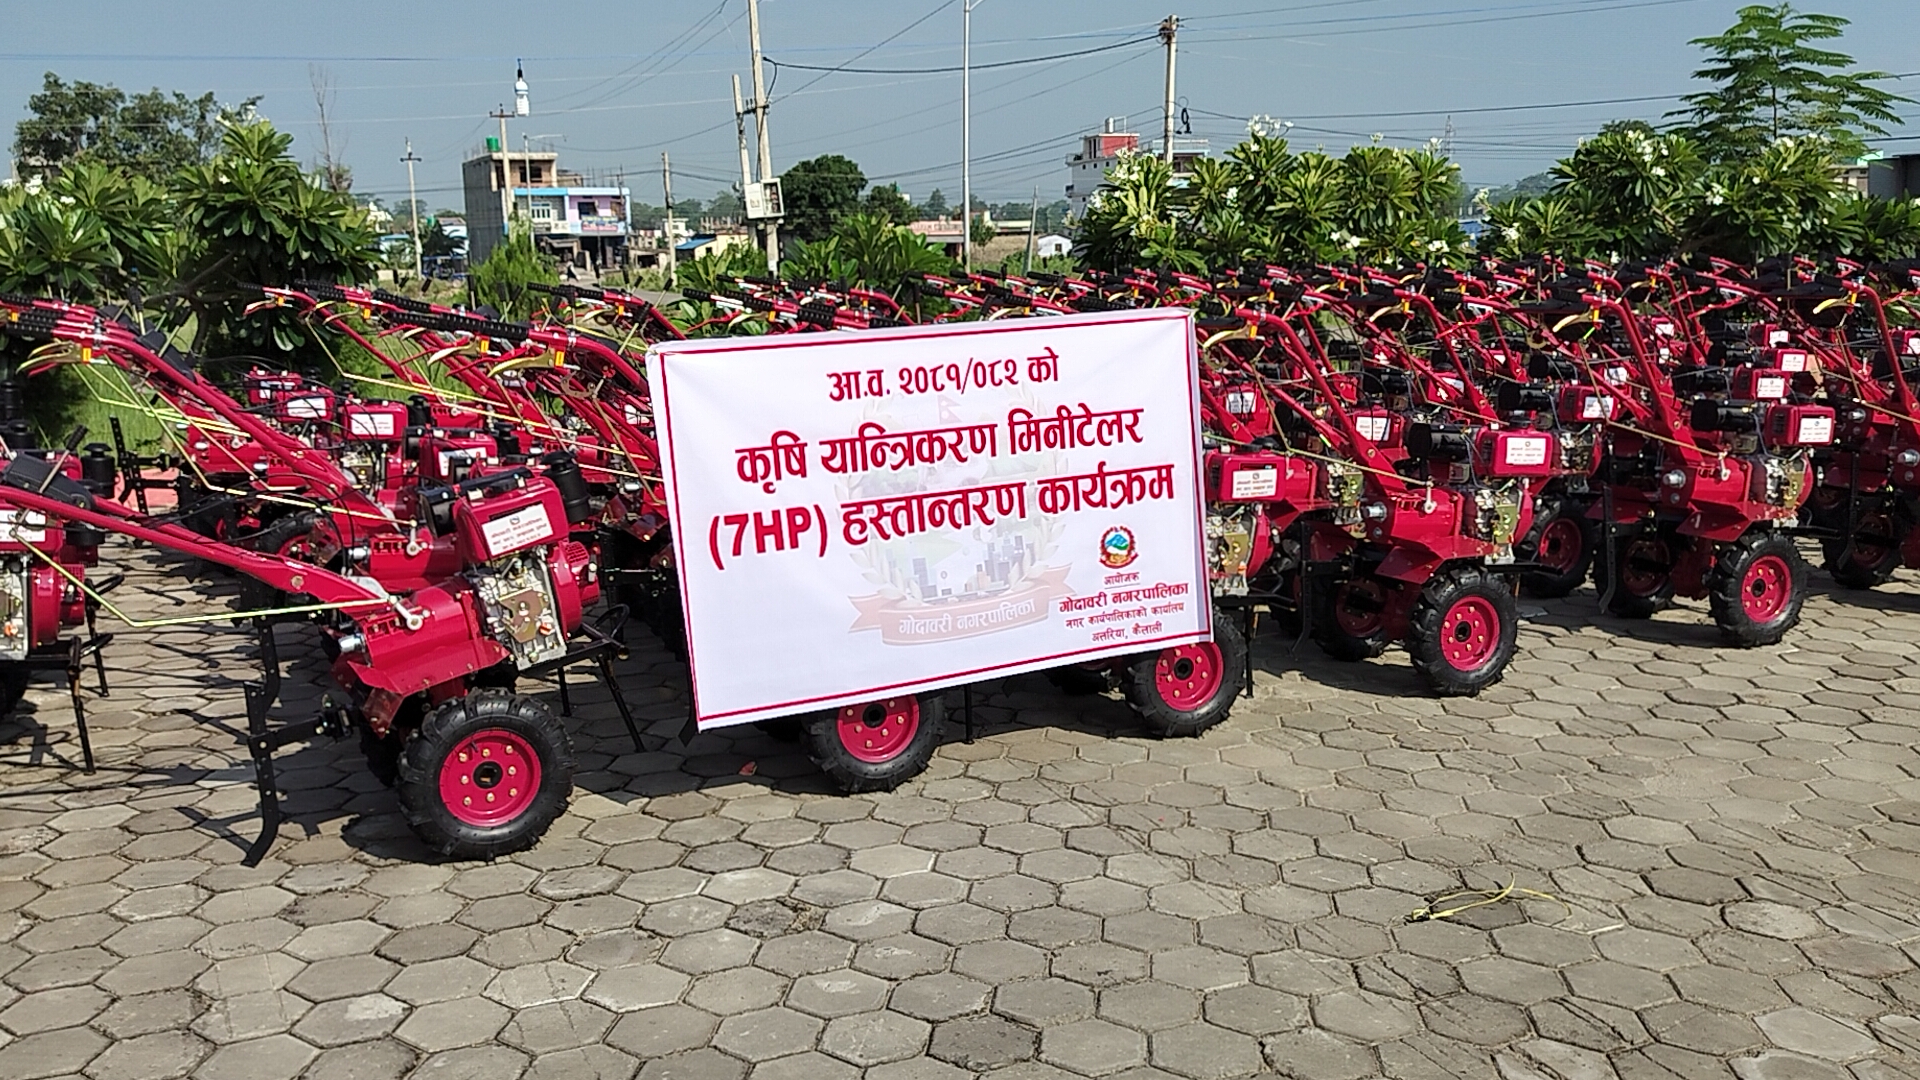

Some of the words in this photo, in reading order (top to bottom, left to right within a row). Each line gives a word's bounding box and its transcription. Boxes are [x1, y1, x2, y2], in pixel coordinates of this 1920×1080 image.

[827, 369, 890, 401] आ.व.
[899, 358, 1018, 394] २०८१/०८२
[1027, 347, 1058, 383] को
[735, 430, 808, 494] कृषि
[819, 424, 998, 474] यान्त्रिकरण
[1008, 403, 1144, 455] मिनीटेलर
[709, 504, 828, 570] (7HP)
[840, 482, 1027, 545] हस्तान्तरण
[1037, 462, 1174, 514] कार्यक्रम
[1105, 571, 1140, 585] आयोजक
[1059, 592, 1107, 612] गोदावरी
[1111, 583, 1188, 603] नगरपालिका
[899, 614, 952, 635] गोदावरी
[956, 598, 1036, 629] नगरपालिका
[1065, 617, 1085, 628] नगर
